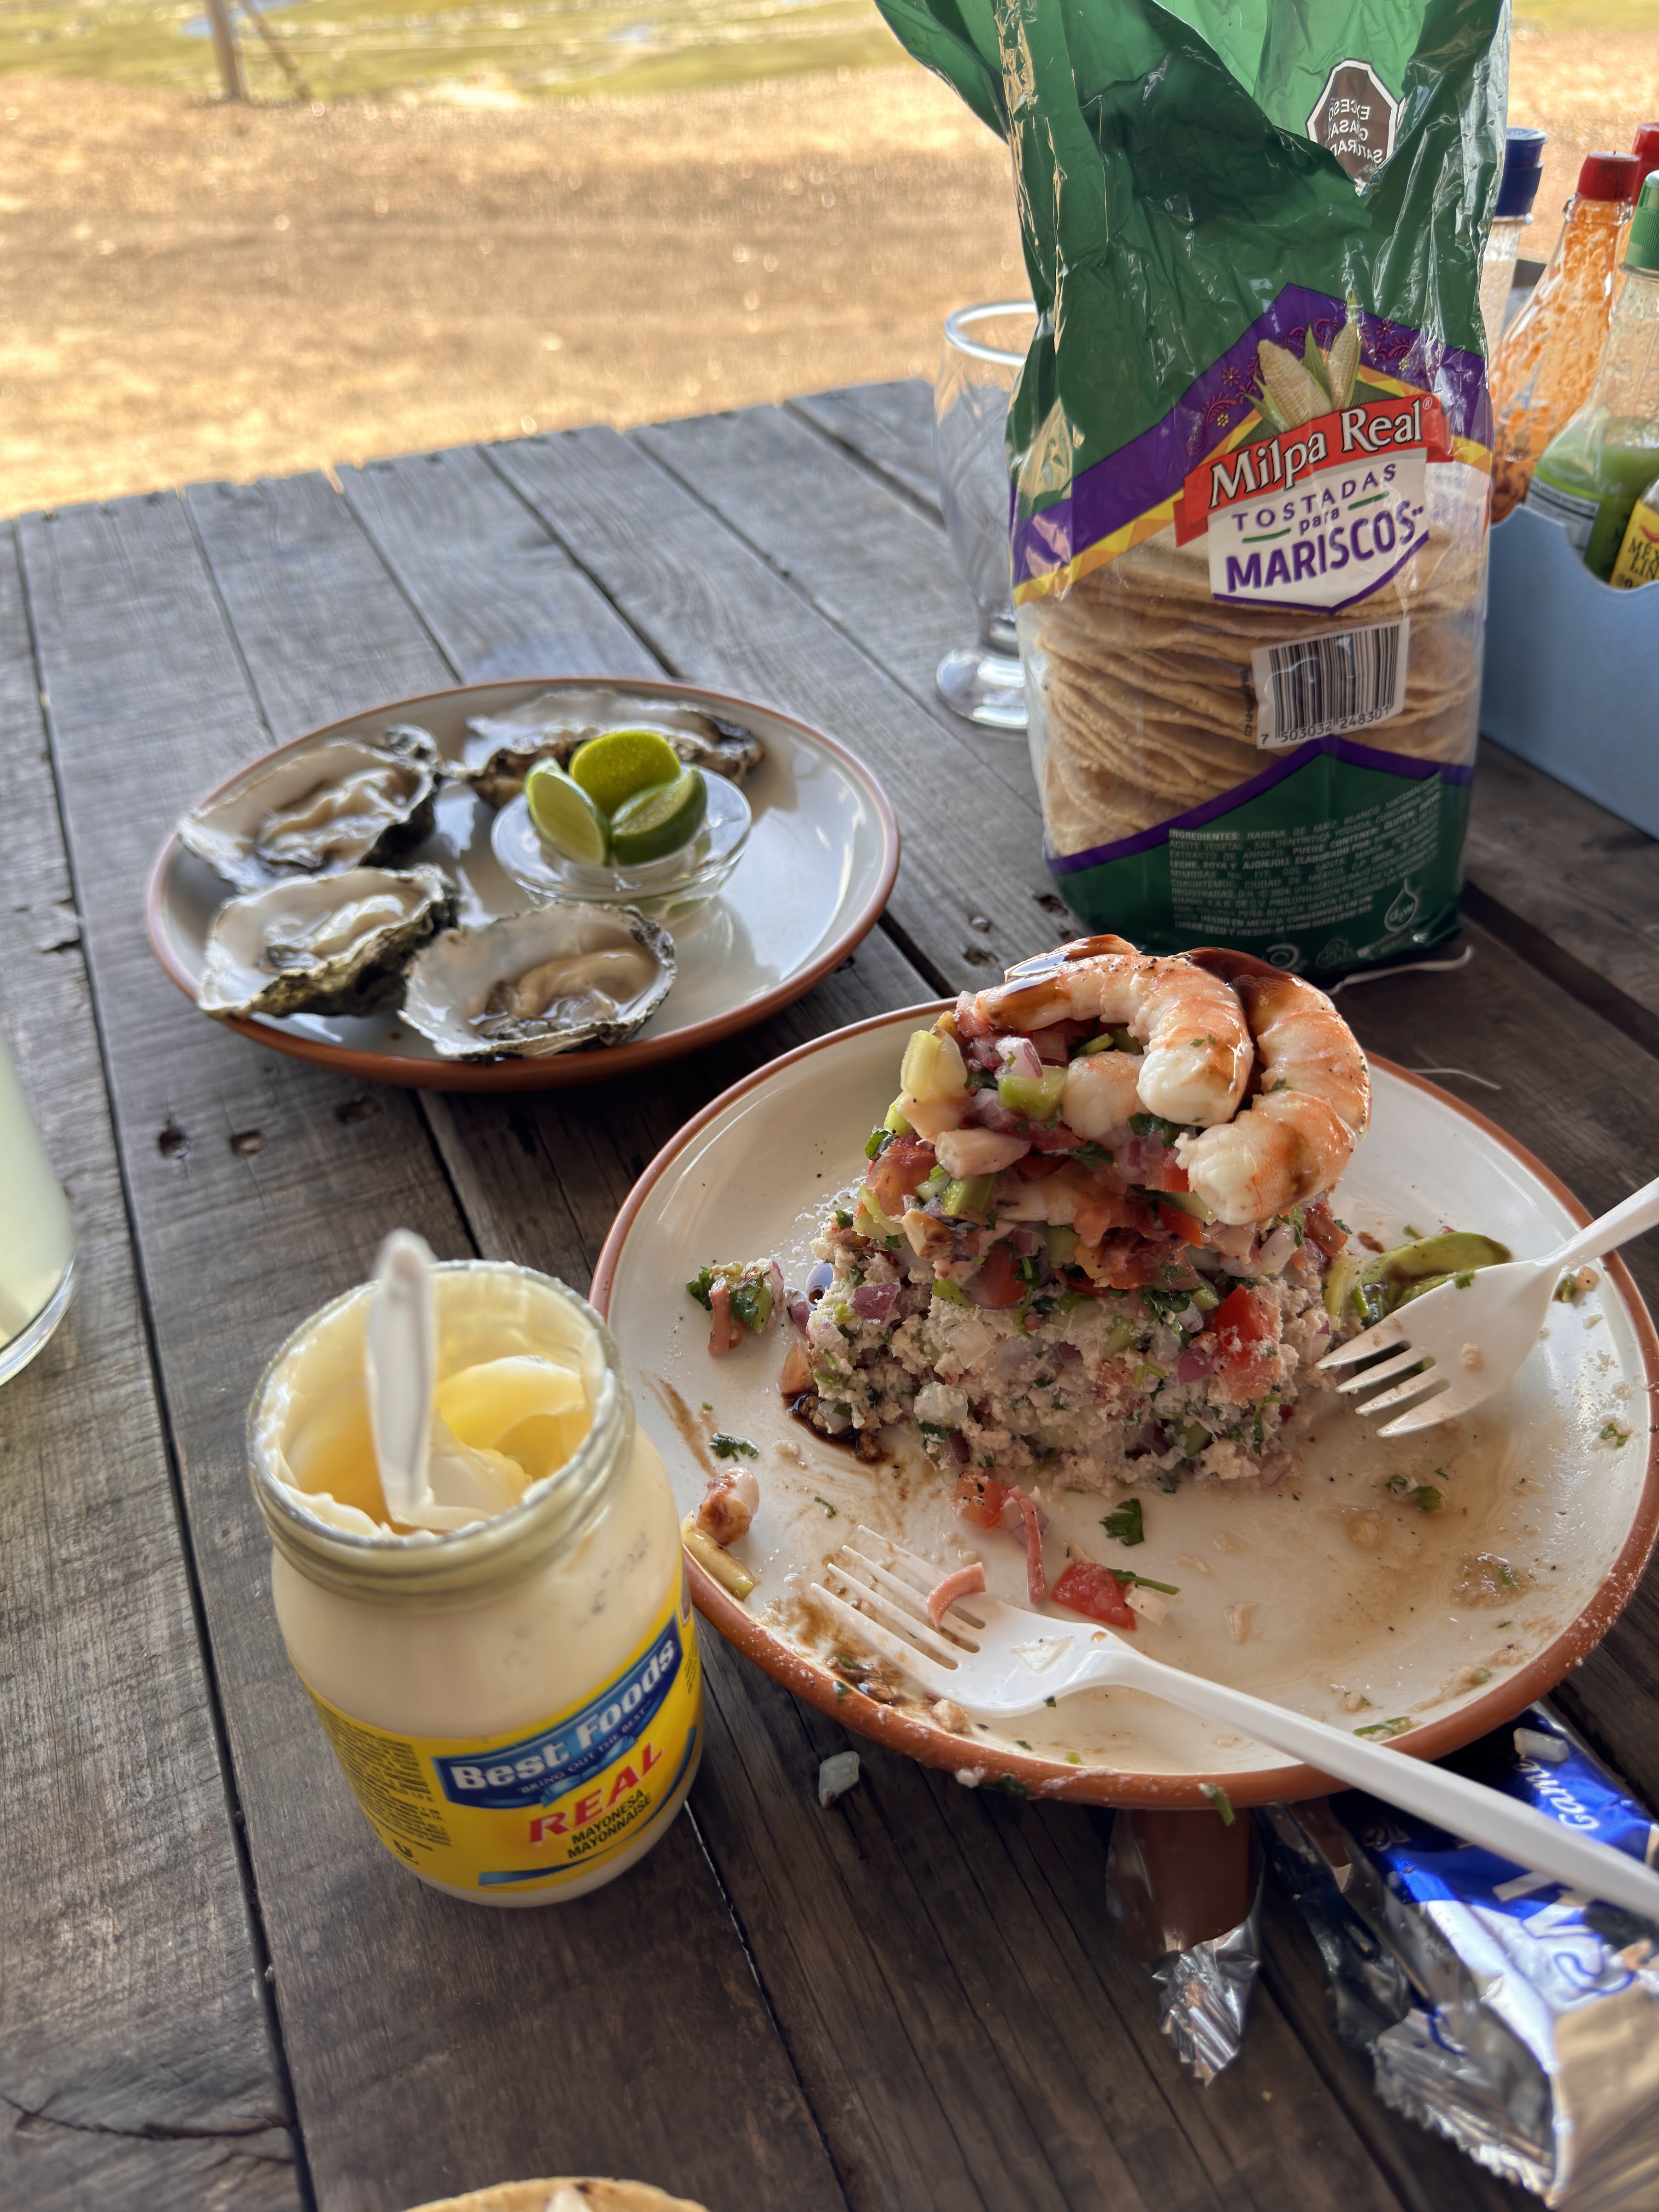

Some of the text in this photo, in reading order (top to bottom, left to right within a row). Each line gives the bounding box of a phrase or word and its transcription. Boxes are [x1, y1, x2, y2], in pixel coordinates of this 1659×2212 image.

[1209, 431, 1328, 509] Milpa
[1231, 464, 1396, 532] TOSTADAS
[1298, 507, 1340, 536] para
[1260, 734, 1269, 745] 7
[1280, 721, 1332, 743] 503032
[450, 1741, 571, 1789] Best
[576, 1640, 675, 1749] Foods
[529, 1741, 665, 1843] REAL
[571, 1789, 644, 1845] MAYONESA
[567, 1793, 652, 1859] MAYONNAISE
